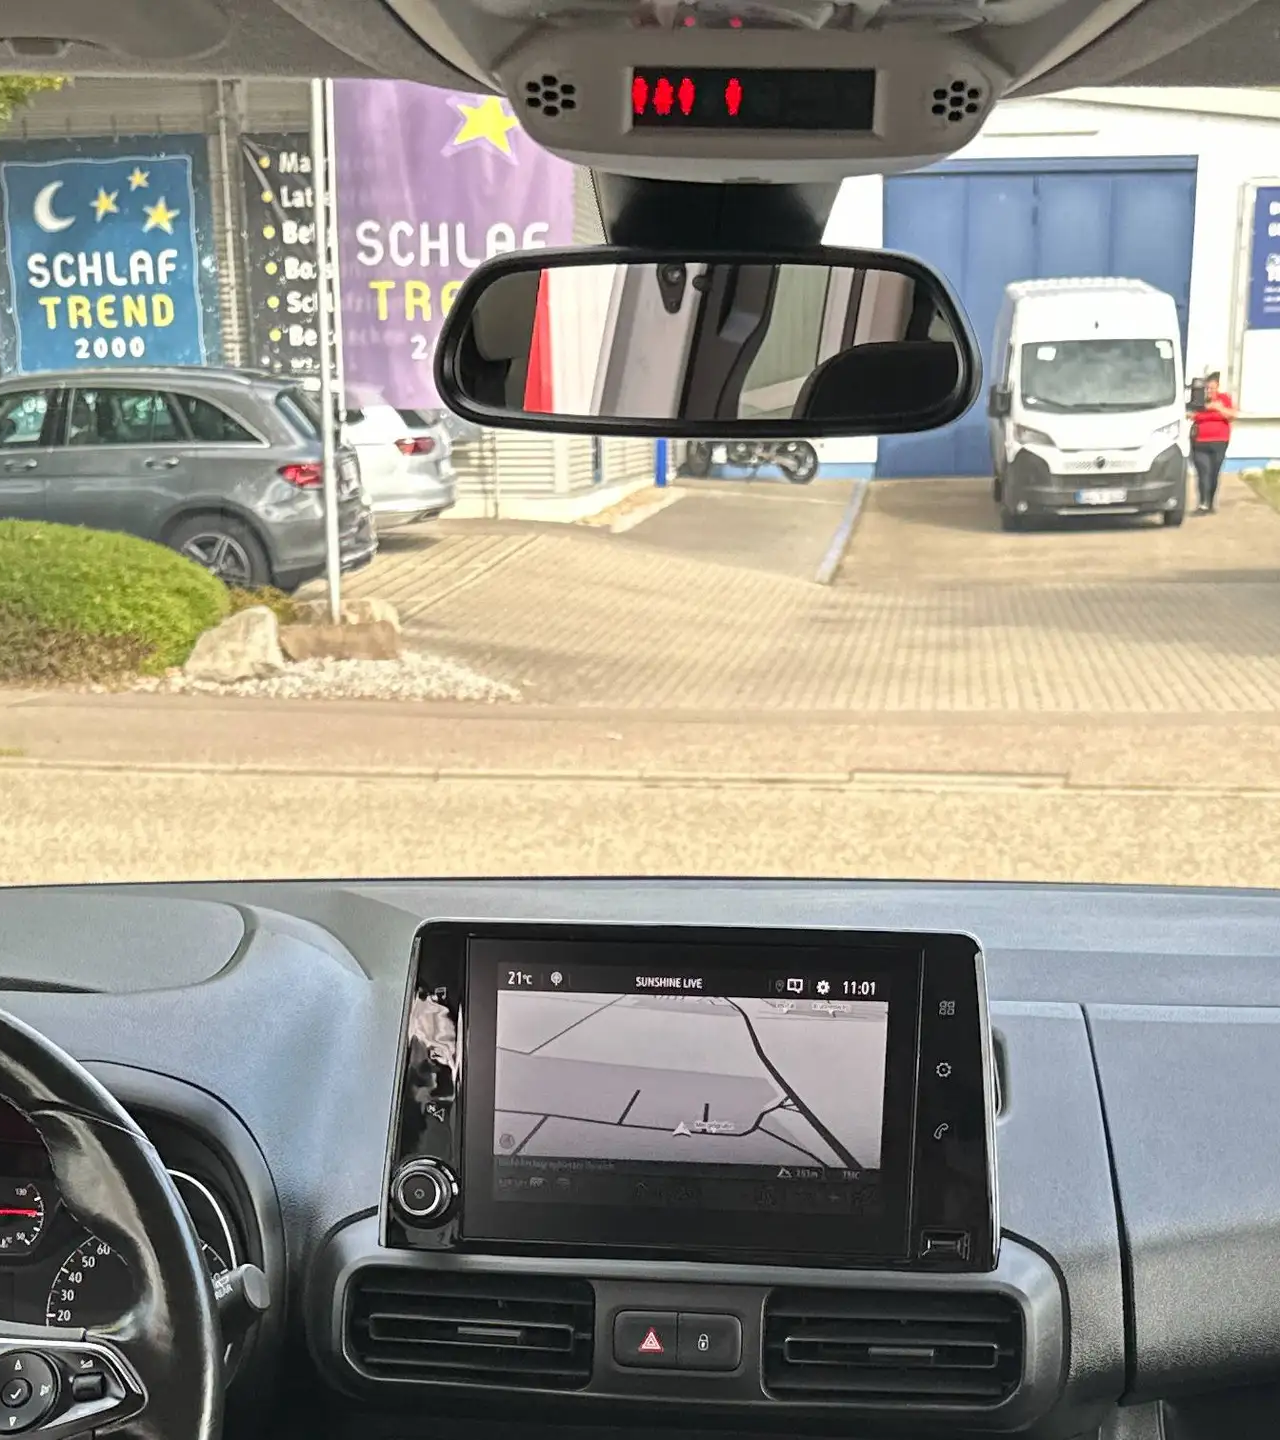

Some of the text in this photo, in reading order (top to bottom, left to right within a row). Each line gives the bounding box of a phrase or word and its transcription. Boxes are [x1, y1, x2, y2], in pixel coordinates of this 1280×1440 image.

[27, 249, 178, 288] SCHLAF
[38, 293, 175, 330] TREND
[75, 336, 145, 359] 2000
[635, 976, 703, 989] SUNSHINE LIVE
[843, 980, 876, 996] 11:01
[97, 1243, 111, 1256] 60
[81, 1256, 95, 1268] 50
[68, 1272, 82, 1283] 40
[61, 1289, 74, 1301] 30
[57, 1310, 71, 1321] 20
